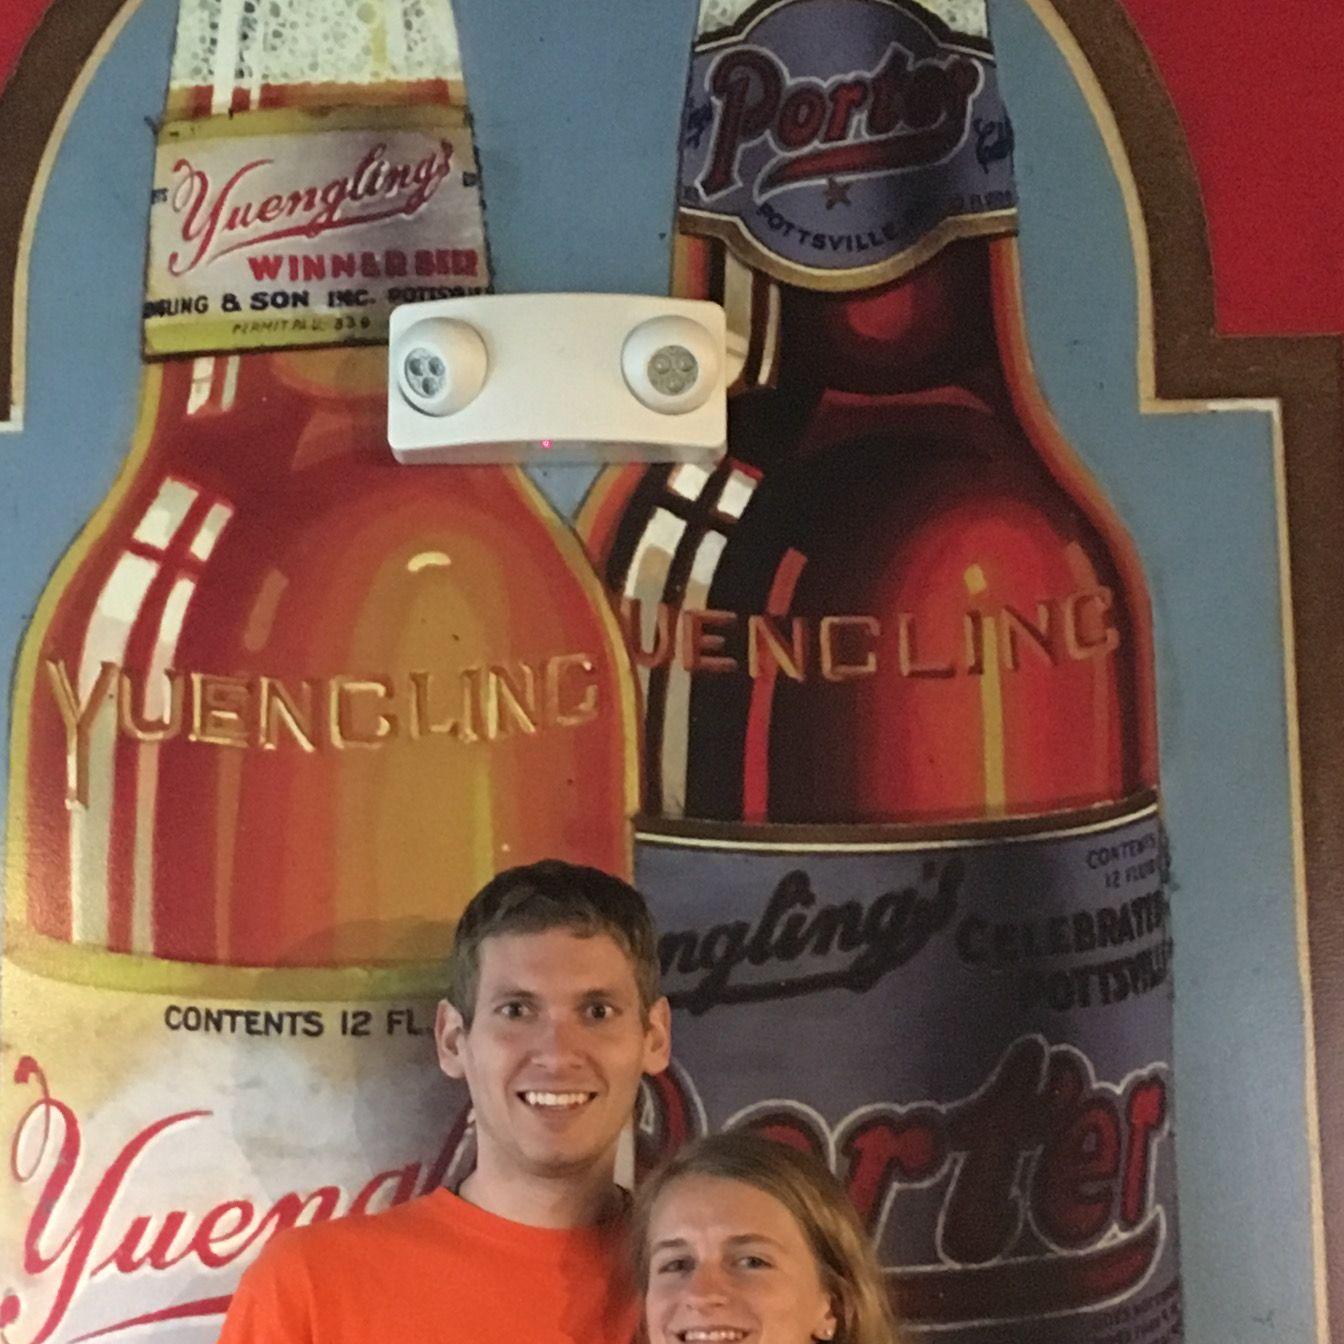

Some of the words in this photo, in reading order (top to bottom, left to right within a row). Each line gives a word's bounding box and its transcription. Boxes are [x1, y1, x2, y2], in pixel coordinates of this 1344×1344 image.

[694, 42, 984, 202] Porter
[758, 204, 902, 252] POTTSVILLE
[248, 249, 407, 283] WINNER
[414, 248, 479, 278] BEER
[222, 294, 243, 312] &
[250, 290, 310, 312] SON
[47, 654, 598, 811] YUENGLING
[164, 1005, 324, 1037] CONTENTS
[340, 1010, 372, 1035] 12
